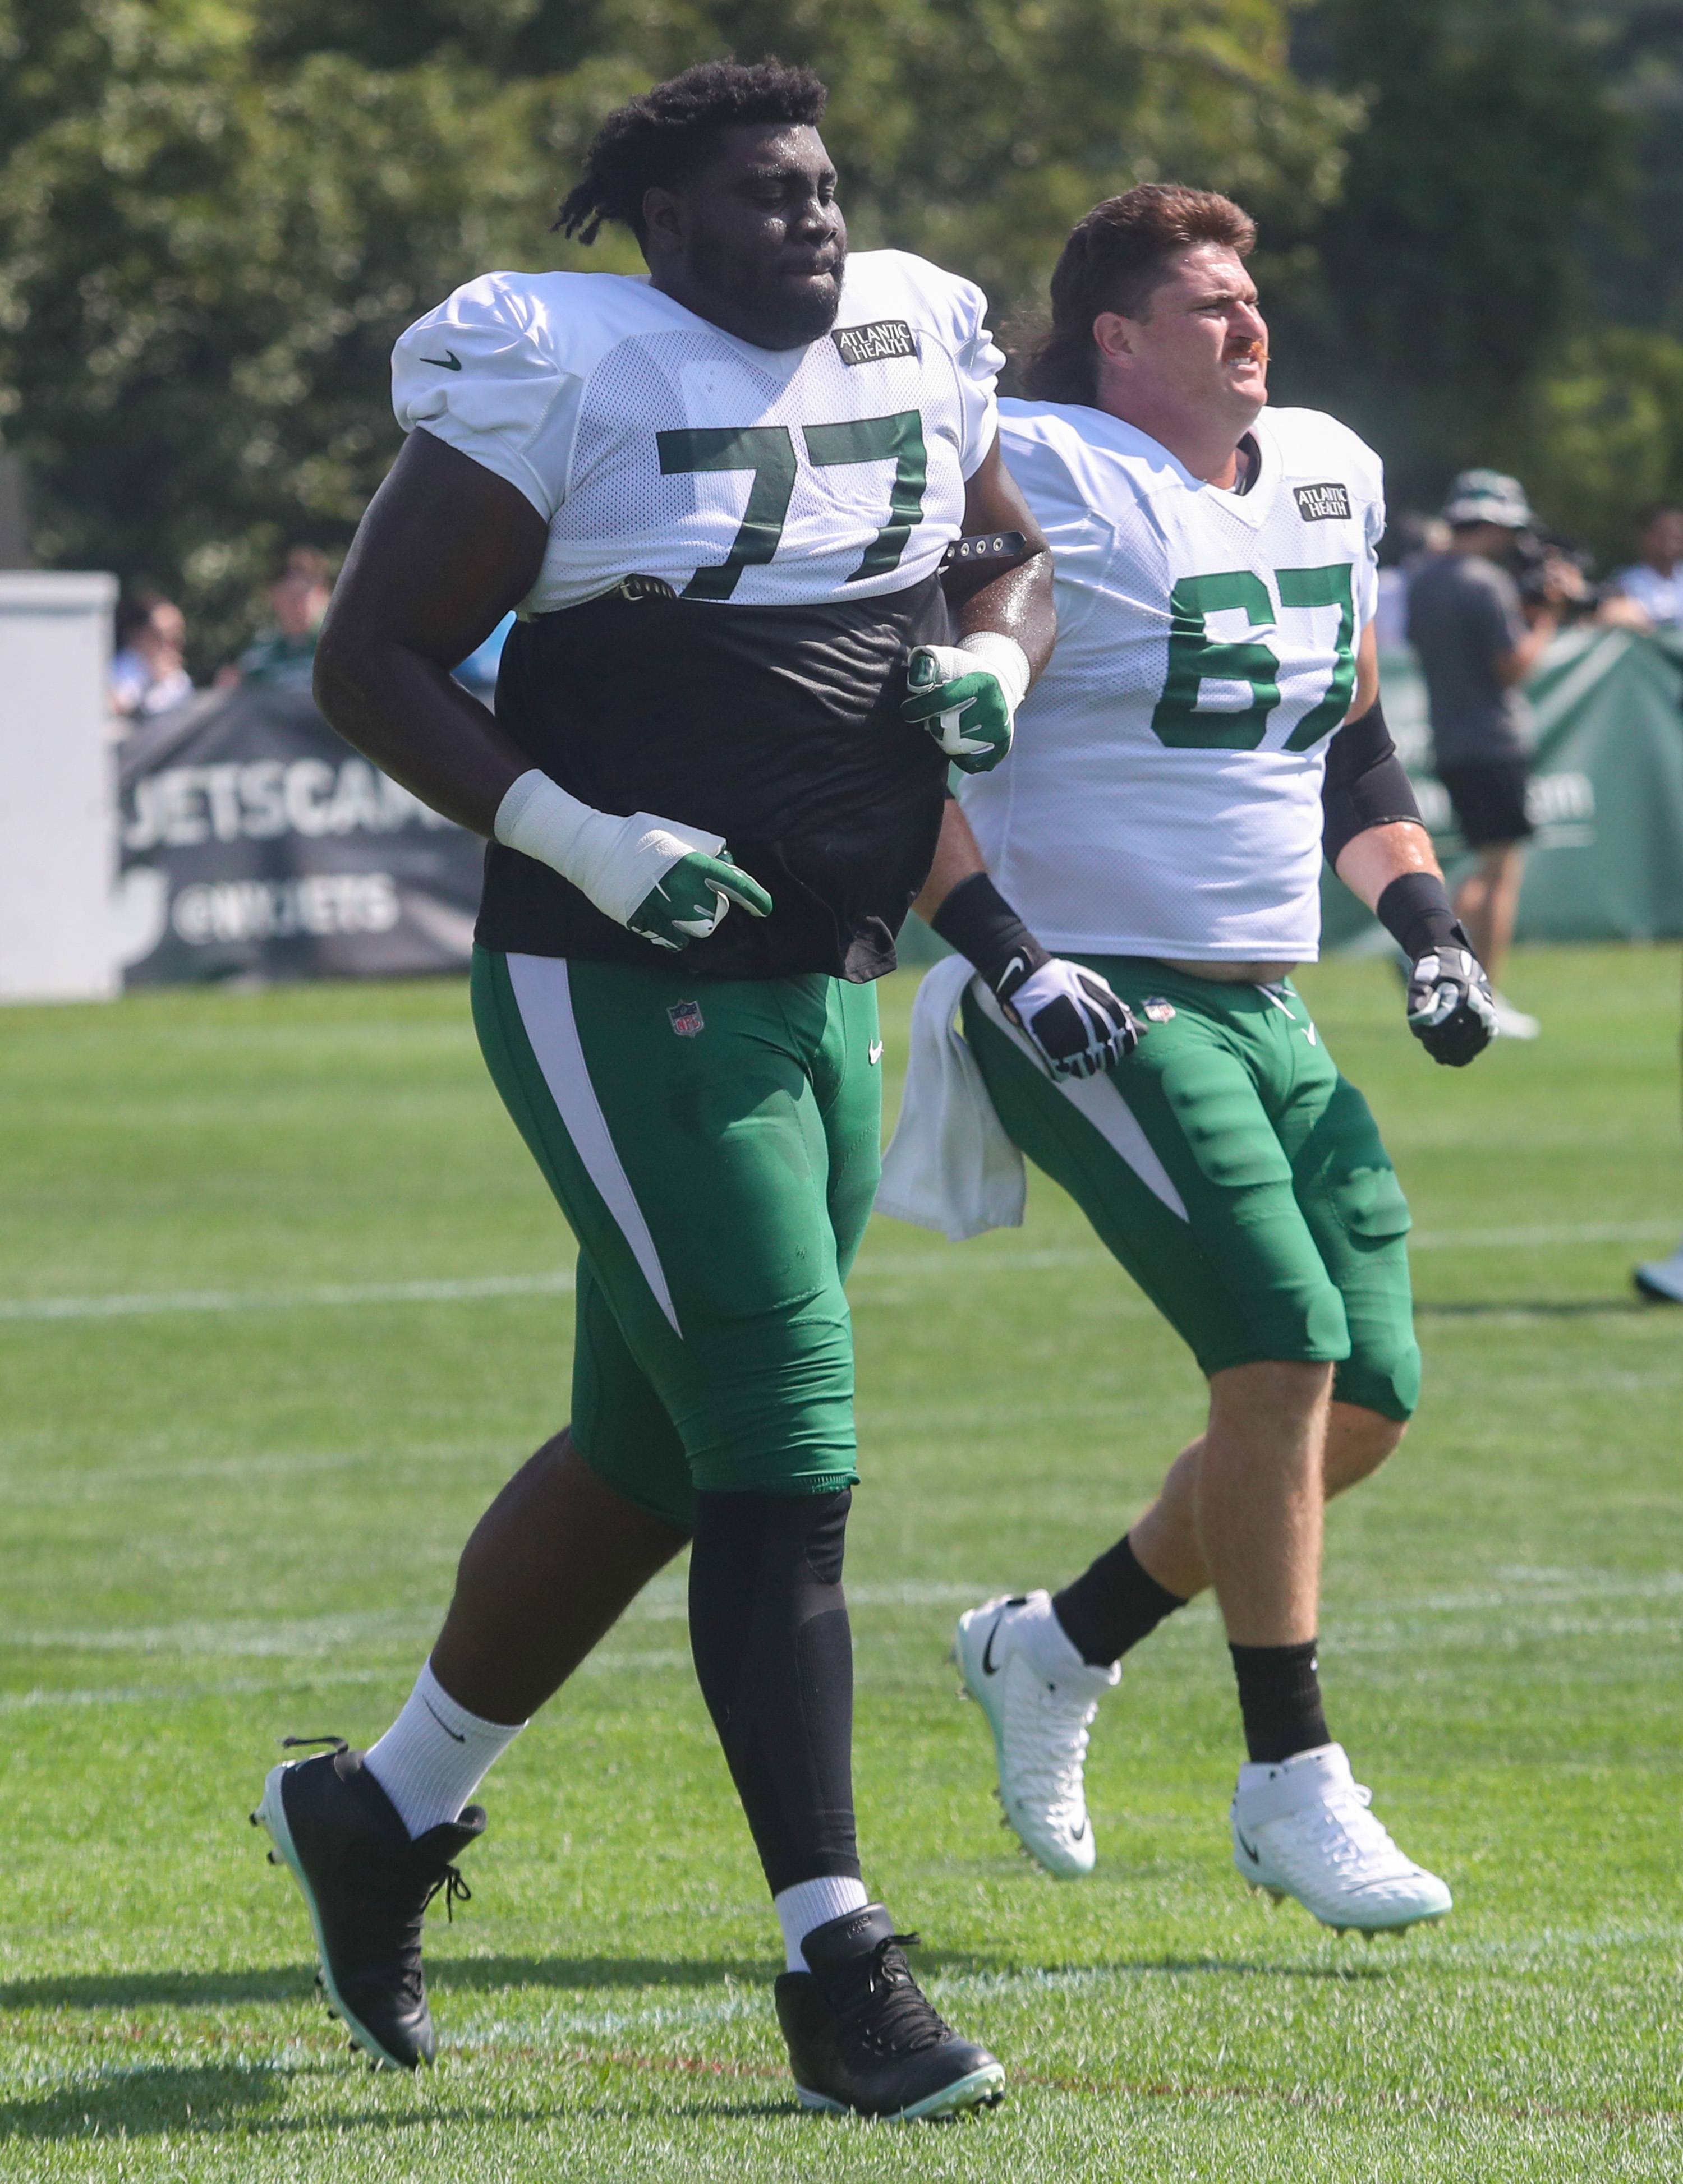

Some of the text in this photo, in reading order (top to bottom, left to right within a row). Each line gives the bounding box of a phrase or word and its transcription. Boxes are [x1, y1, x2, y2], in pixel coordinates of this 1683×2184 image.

[840, 324, 910, 348] ATLANTIC
[852, 337, 909, 360] HEALTH
[656, 409, 927, 600] 77
[1299, 487, 1347, 505] ATLANTIC
[1308, 500, 1348, 517] HEALTH
[1150, 563, 1356, 752] 67
